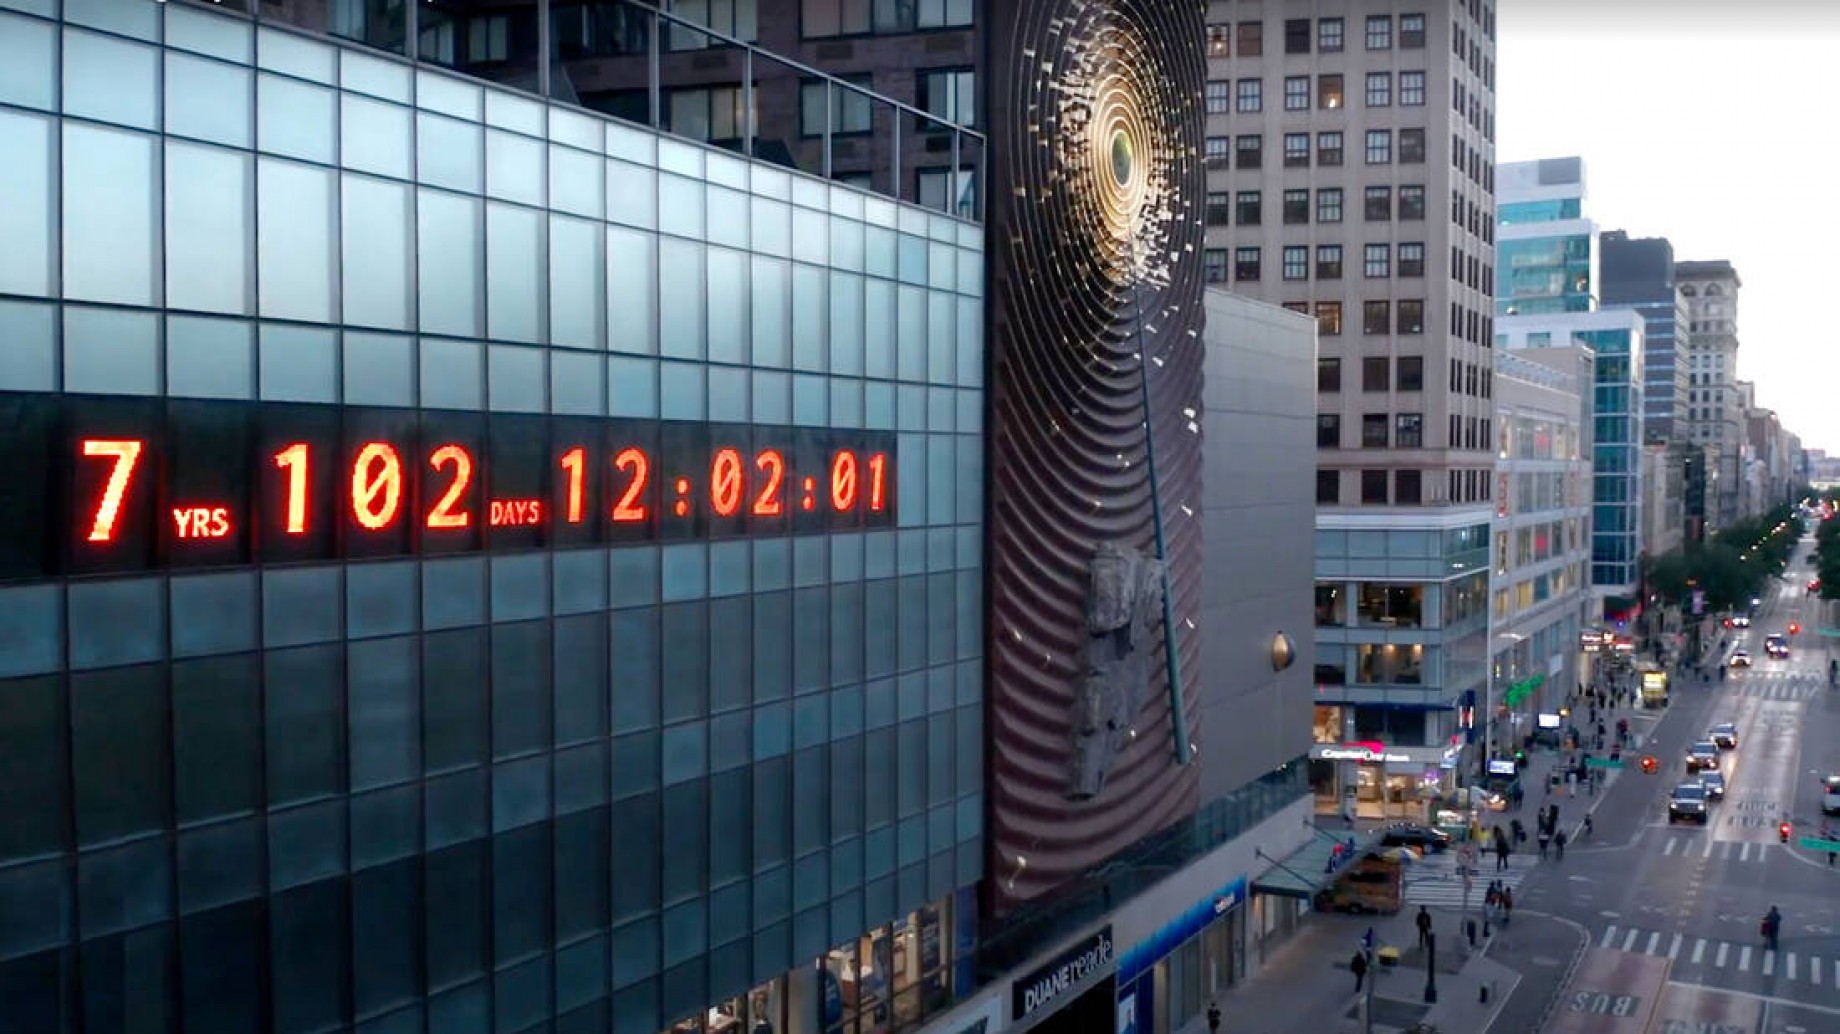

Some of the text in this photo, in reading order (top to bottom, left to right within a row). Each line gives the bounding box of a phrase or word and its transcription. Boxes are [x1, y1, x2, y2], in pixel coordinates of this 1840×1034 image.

[82, 440, 885, 542] 7 YRS 102 DAYS 12:02:01
[1025, 935, 1111, 1012] DUANE reade
[1570, 991, 1633, 1017] BUS
